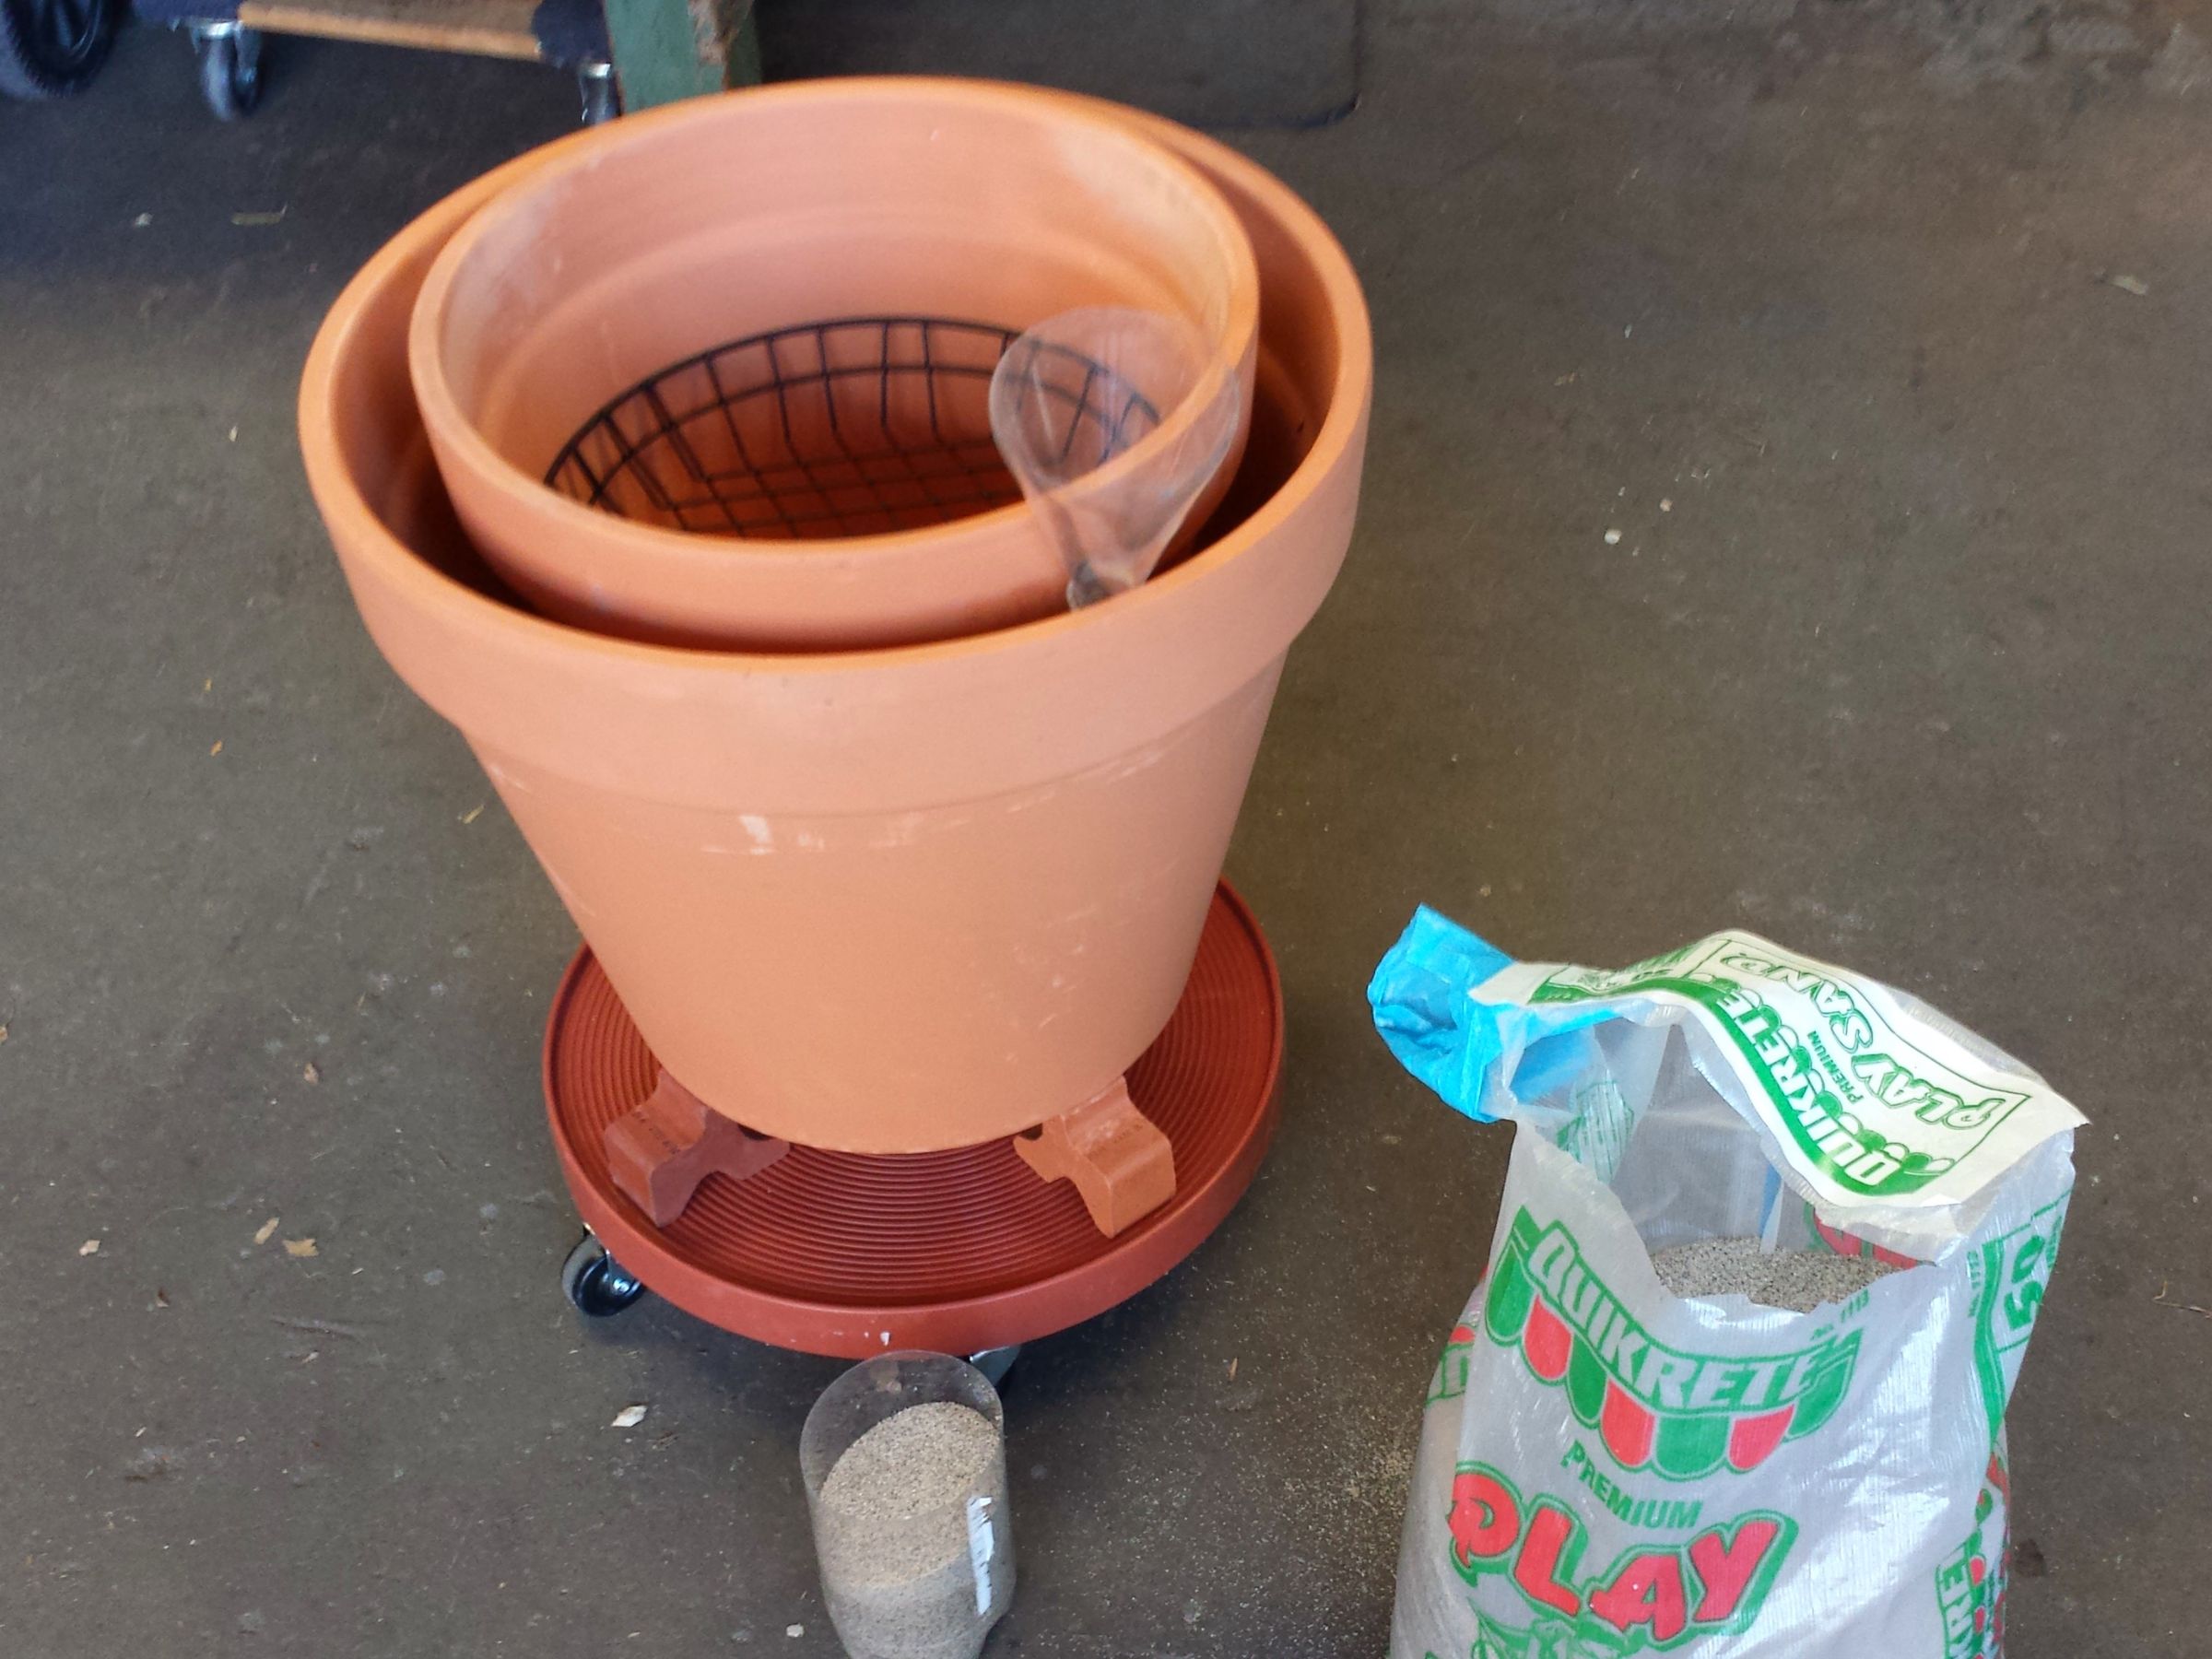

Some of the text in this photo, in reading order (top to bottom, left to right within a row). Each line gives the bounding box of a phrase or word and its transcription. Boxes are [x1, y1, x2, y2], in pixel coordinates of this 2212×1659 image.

[1719, 953, 1875, 1054] SAND
[1715, 988, 1902, 1187] QUIKRETE
[1806, 1030, 1865, 1106] PREMIUM
[1850, 1053, 2007, 1131] PLAY
[1526, 1229, 1827, 1411] QUIKRETE
[2003, 1234, 2046, 1331] 50
[1560, 1439, 1705, 1530] PREMIUM
[1448, 1462, 1795, 1647] PLAY
